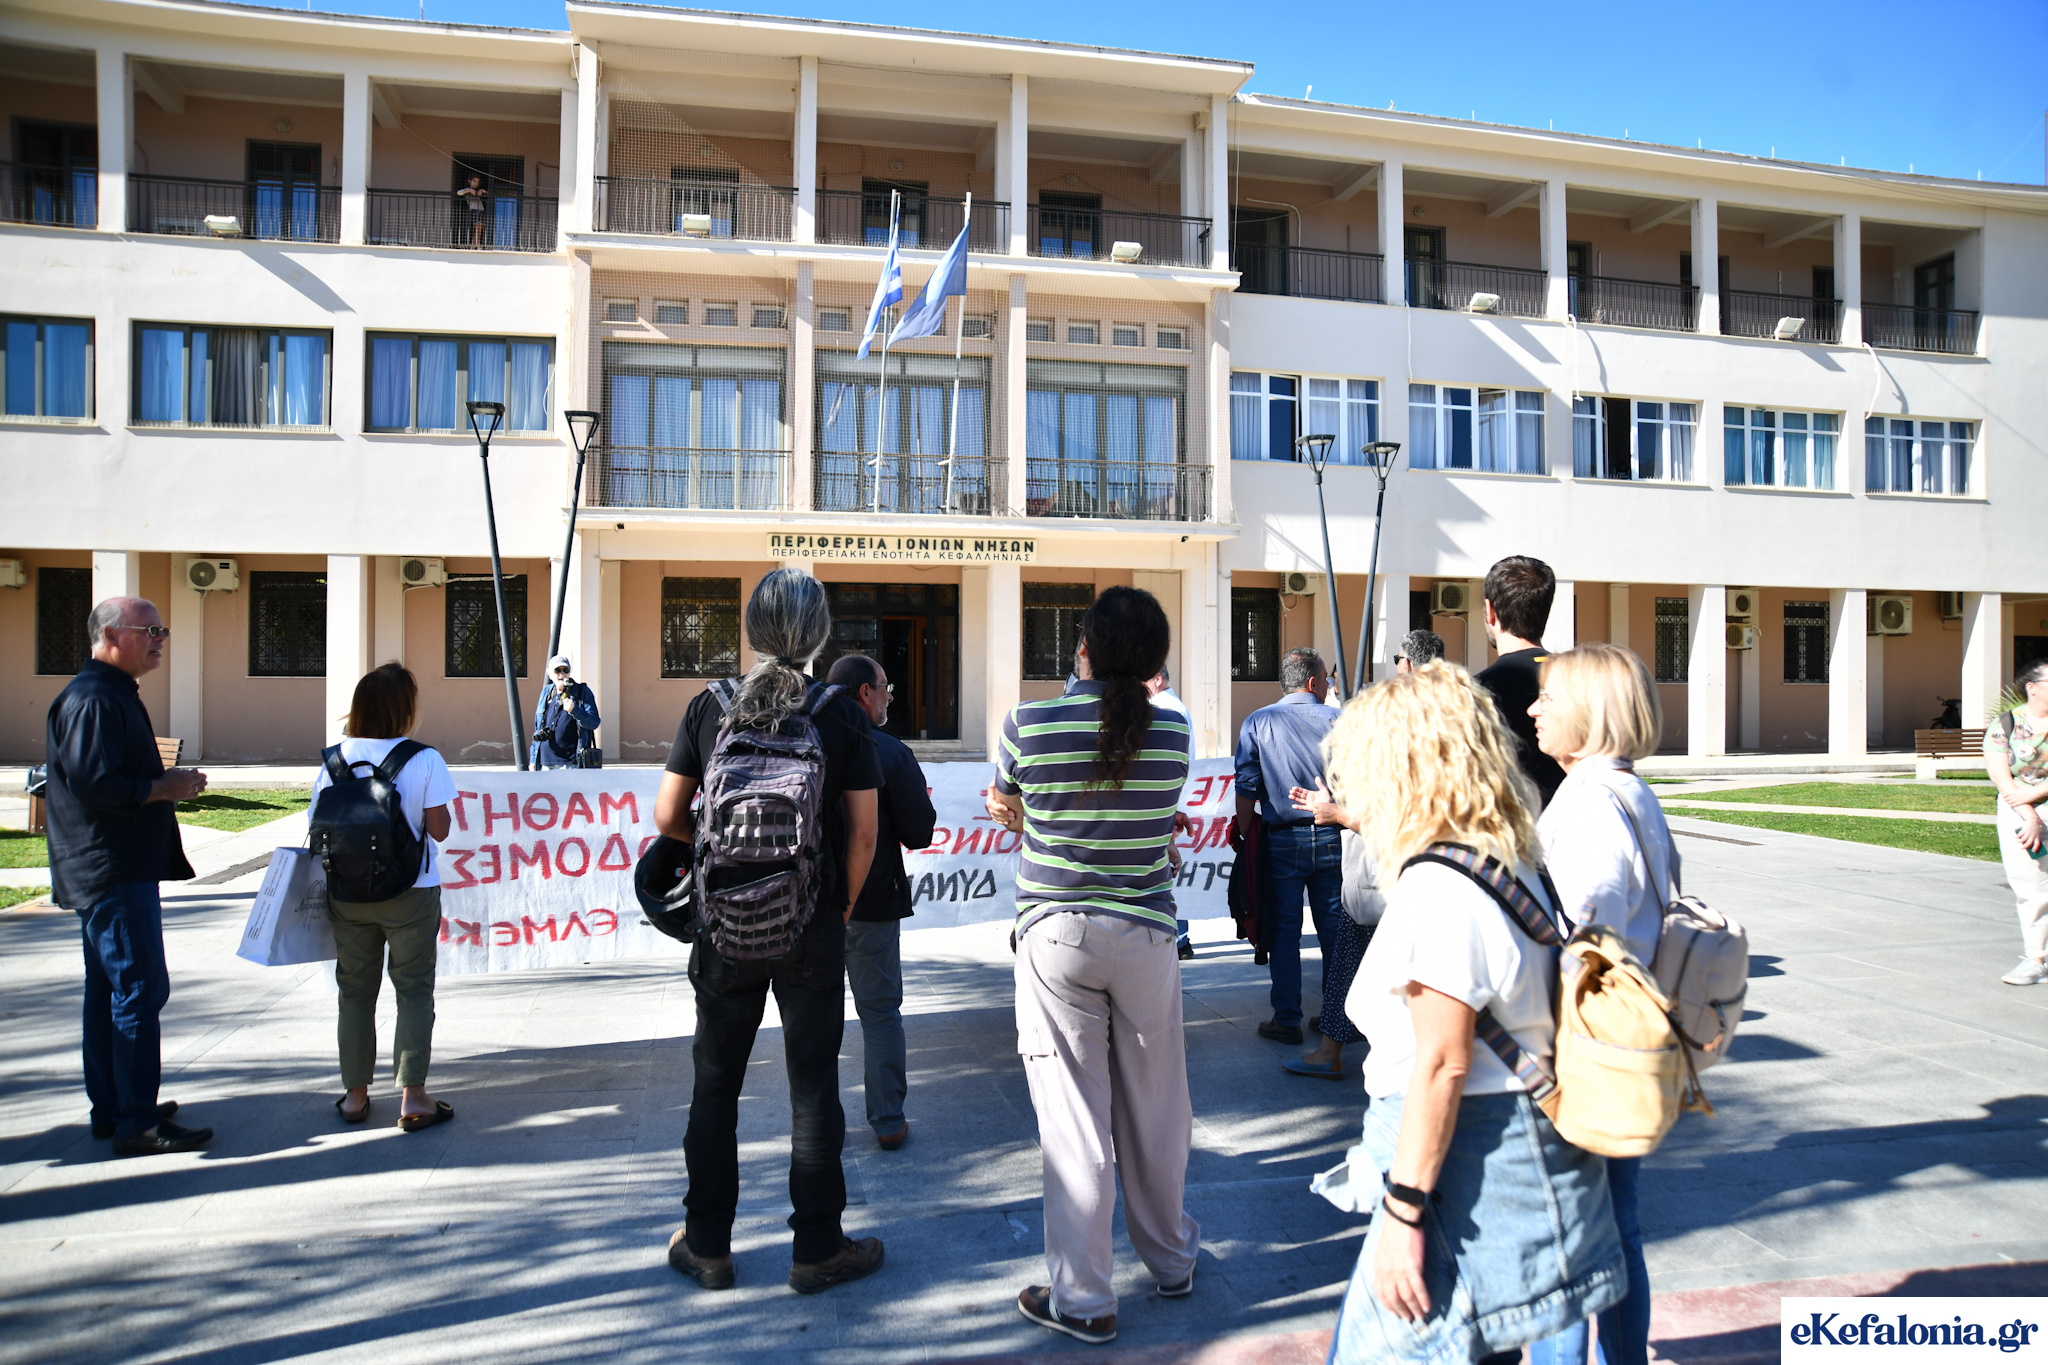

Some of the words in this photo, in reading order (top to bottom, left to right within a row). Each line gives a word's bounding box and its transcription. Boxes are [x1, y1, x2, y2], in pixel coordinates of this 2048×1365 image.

[771, 535, 887, 549] ΠΕΡΙΦΕΡΕΙΑ
[897, 538, 964, 551] ΙΟΝΙΩΝ
[974, 539, 1034, 553] ΝΗΣΩΝ
[772, 548, 866, 559] ΠΕΡΙΦΕΡΕΙΑΚΗ
[873, 550, 930, 560] ΕΝΟΤΗΤΑ
[939, 551, 1031, 562] ΚΕΦΑΛΛΗΝΙΑΣ
